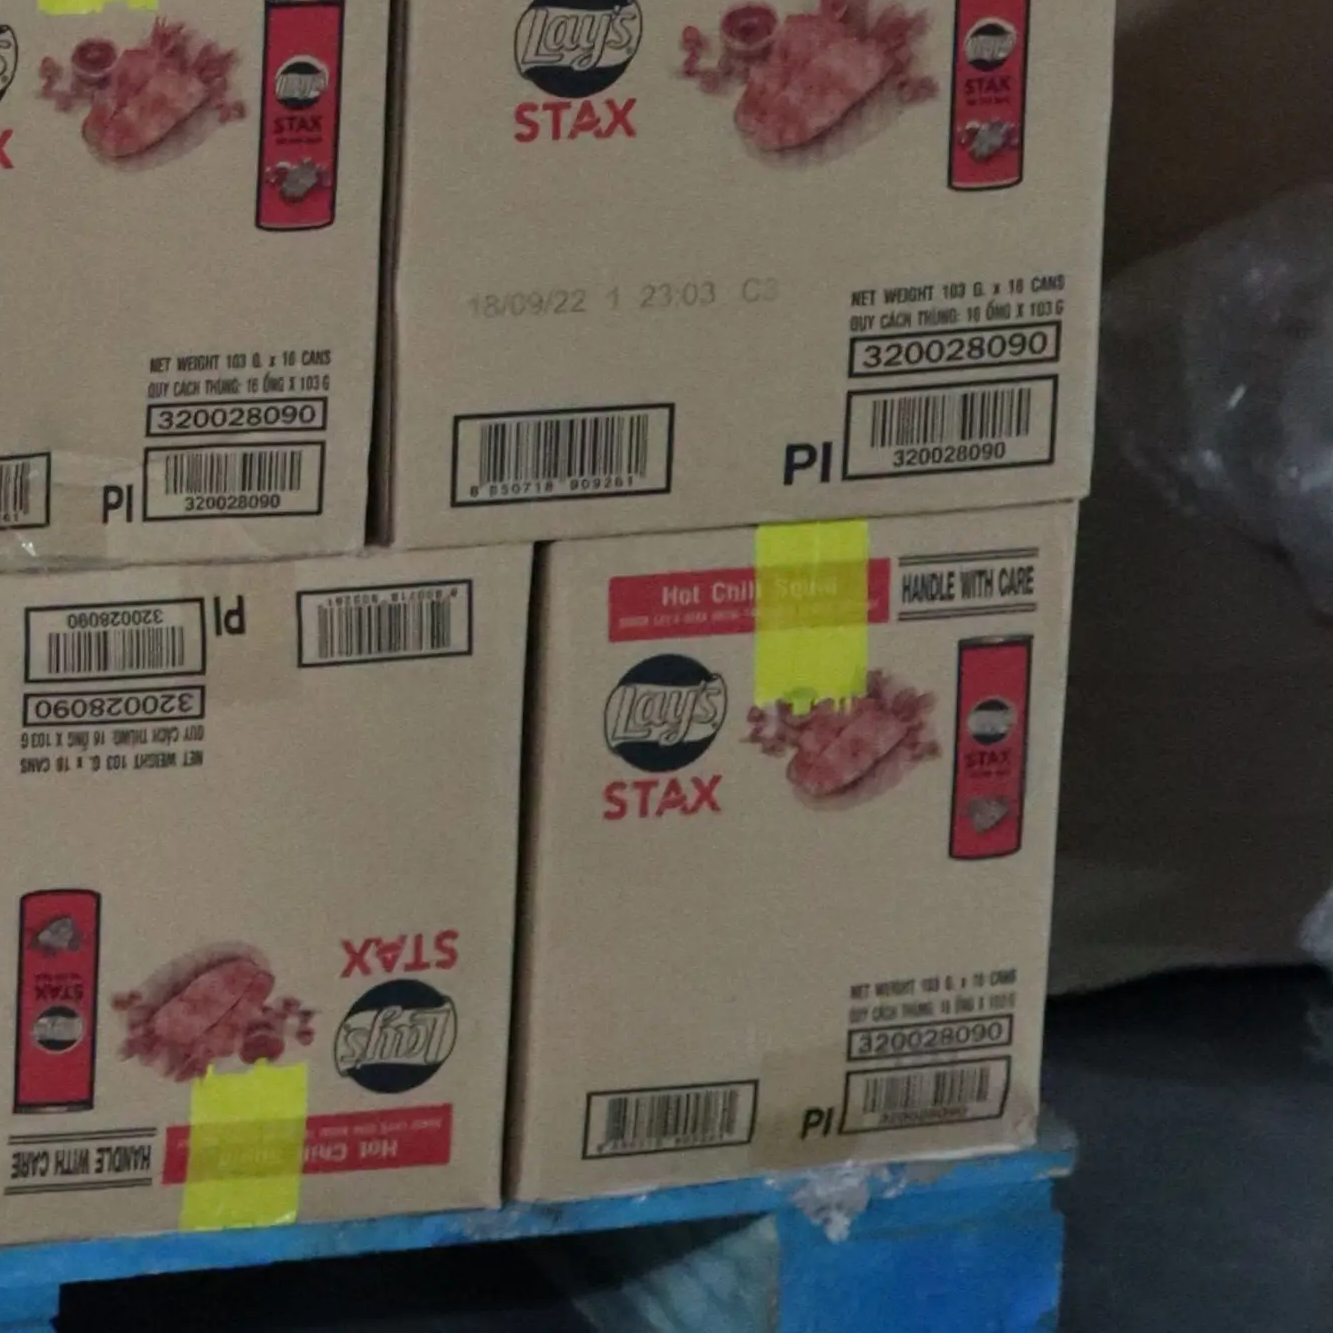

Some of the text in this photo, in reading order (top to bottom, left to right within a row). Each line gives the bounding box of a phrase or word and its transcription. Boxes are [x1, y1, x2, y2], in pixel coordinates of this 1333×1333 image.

[515, 98, 634, 143] STAX
[864, 332, 1047, 368] 320028090
[159, 405, 315, 429] 320028090
[35, 693, 193, 719] 320028090
[604, 775, 720, 820] STAX
[345, 930, 457, 976] STAX
